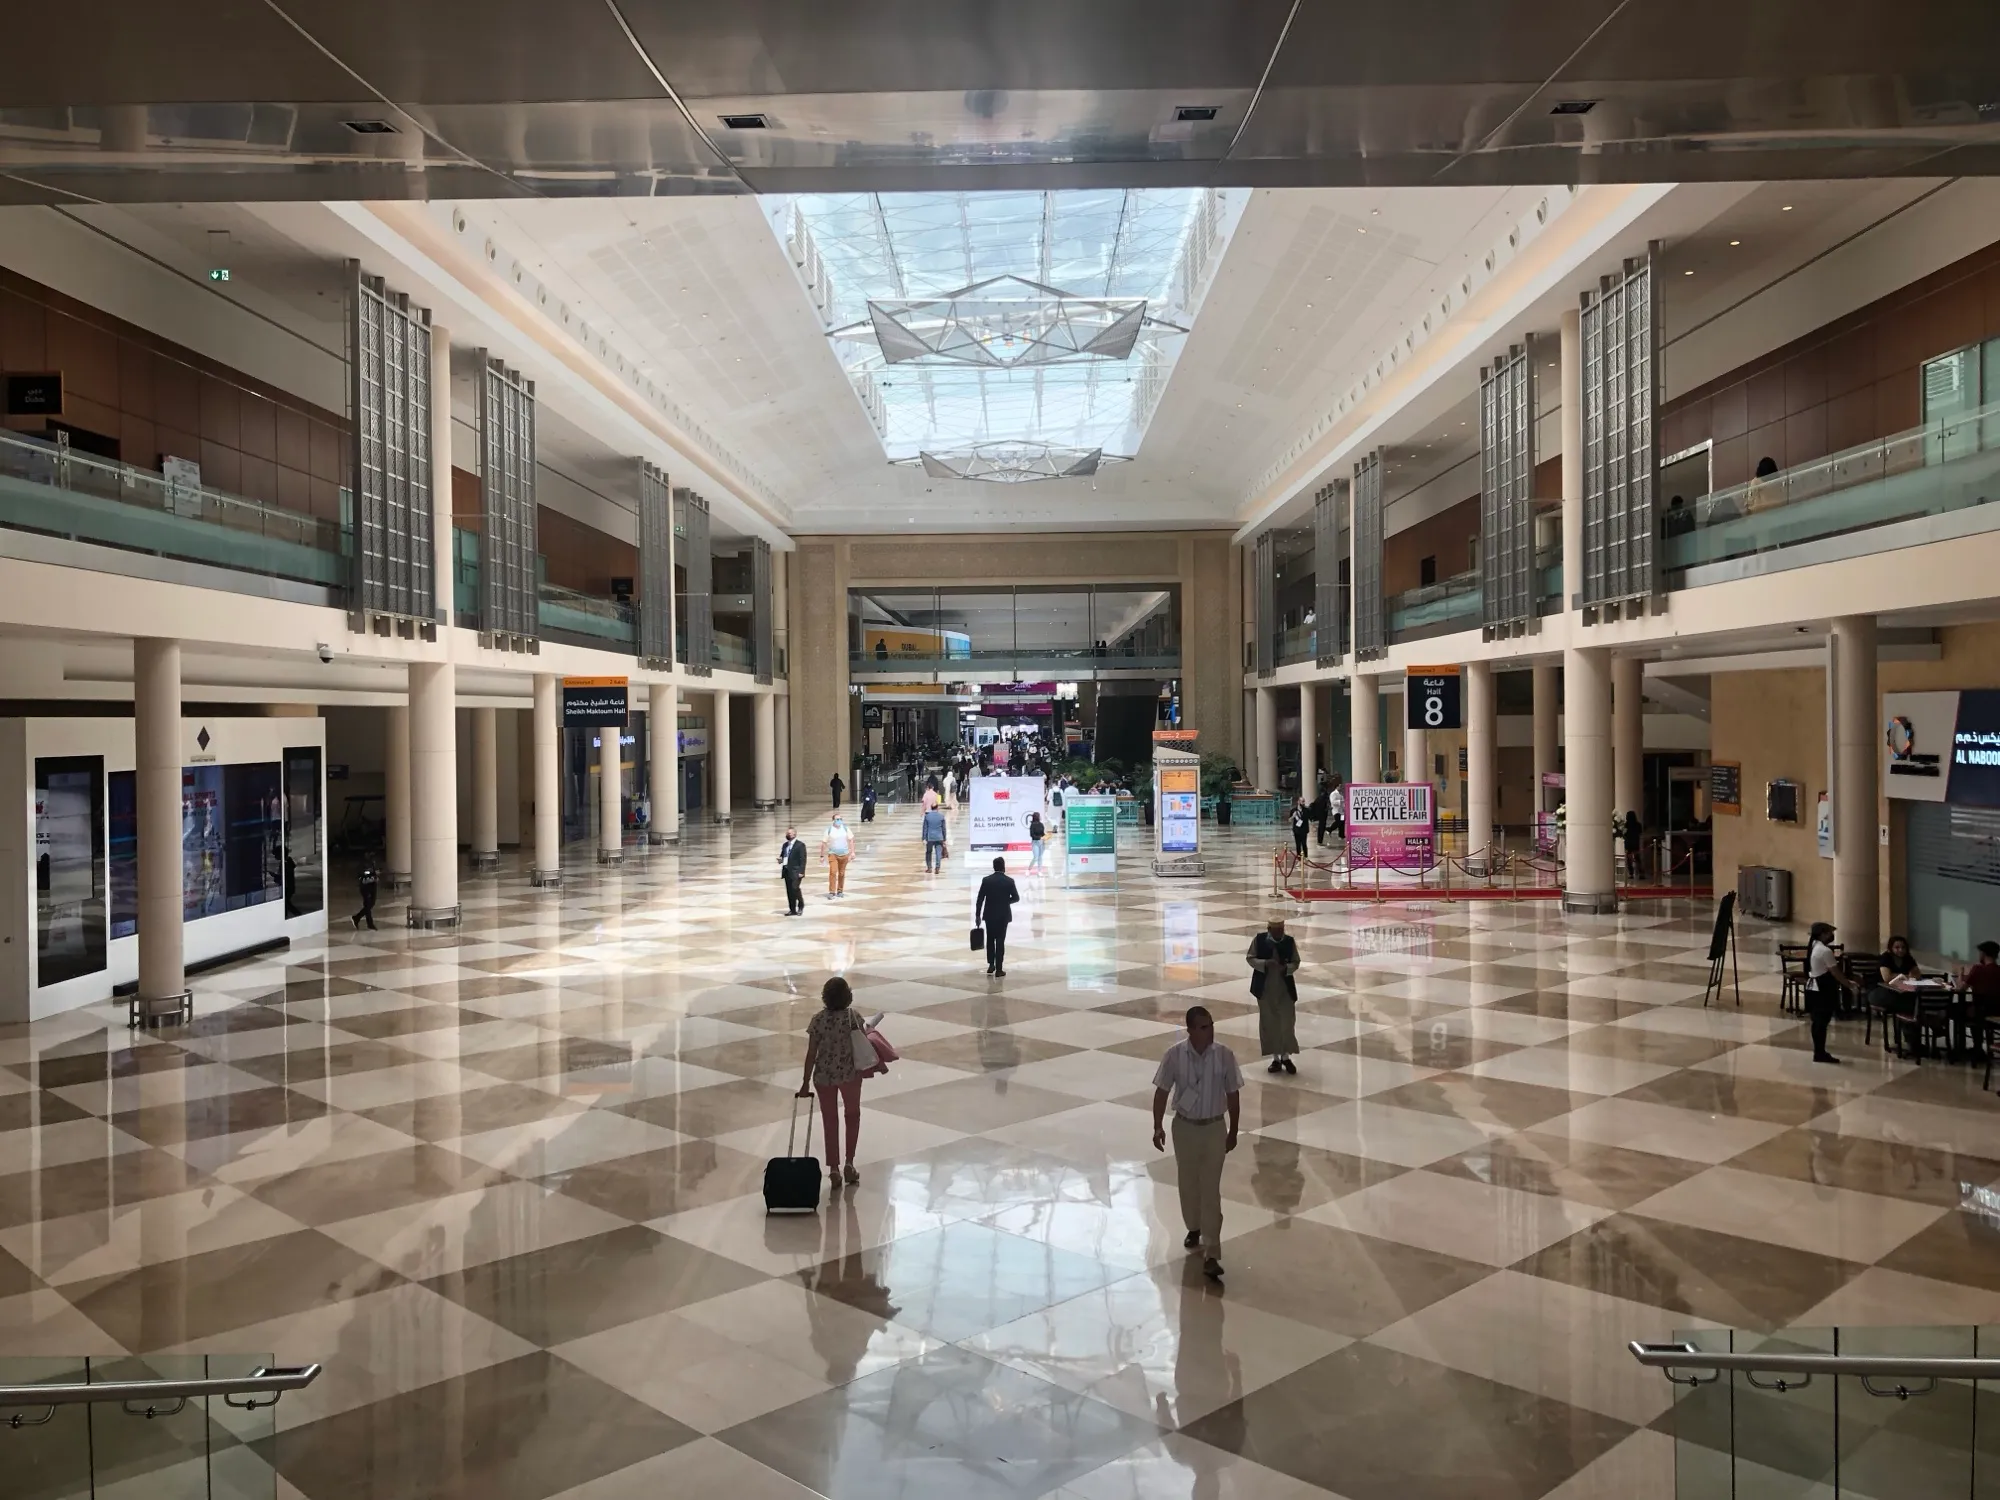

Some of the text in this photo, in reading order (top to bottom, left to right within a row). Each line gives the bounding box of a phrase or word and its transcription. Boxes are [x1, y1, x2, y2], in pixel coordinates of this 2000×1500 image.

[1425, 696, 1443, 726] 8
[1956, 749, 1967, 764] AL
[1352, 788, 1407, 797] INTERNATIONAL
[1353, 807, 1427, 820] TEXTILE FAIR
